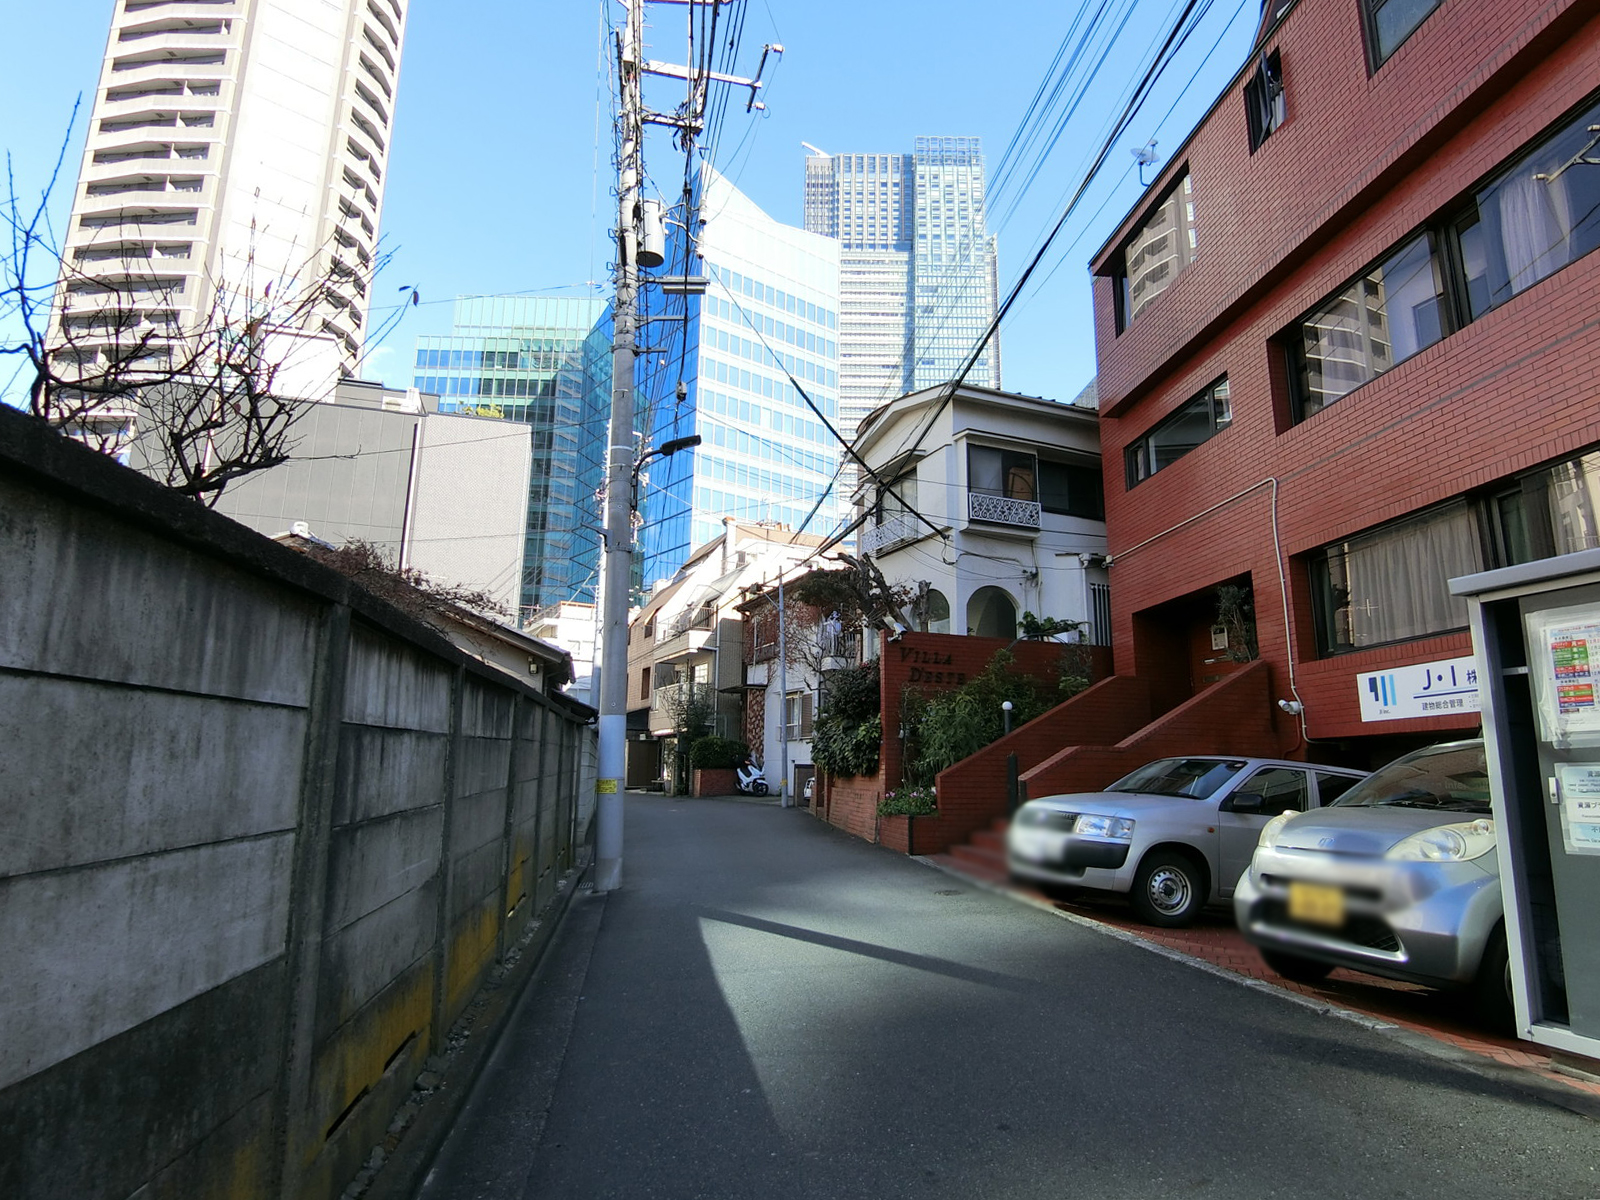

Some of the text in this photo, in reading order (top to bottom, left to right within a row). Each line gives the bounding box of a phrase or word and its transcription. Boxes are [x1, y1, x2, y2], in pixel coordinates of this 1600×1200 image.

[900, 647, 952, 664] VILLA
[1421, 698, 1464, 711] 建物総合管理
